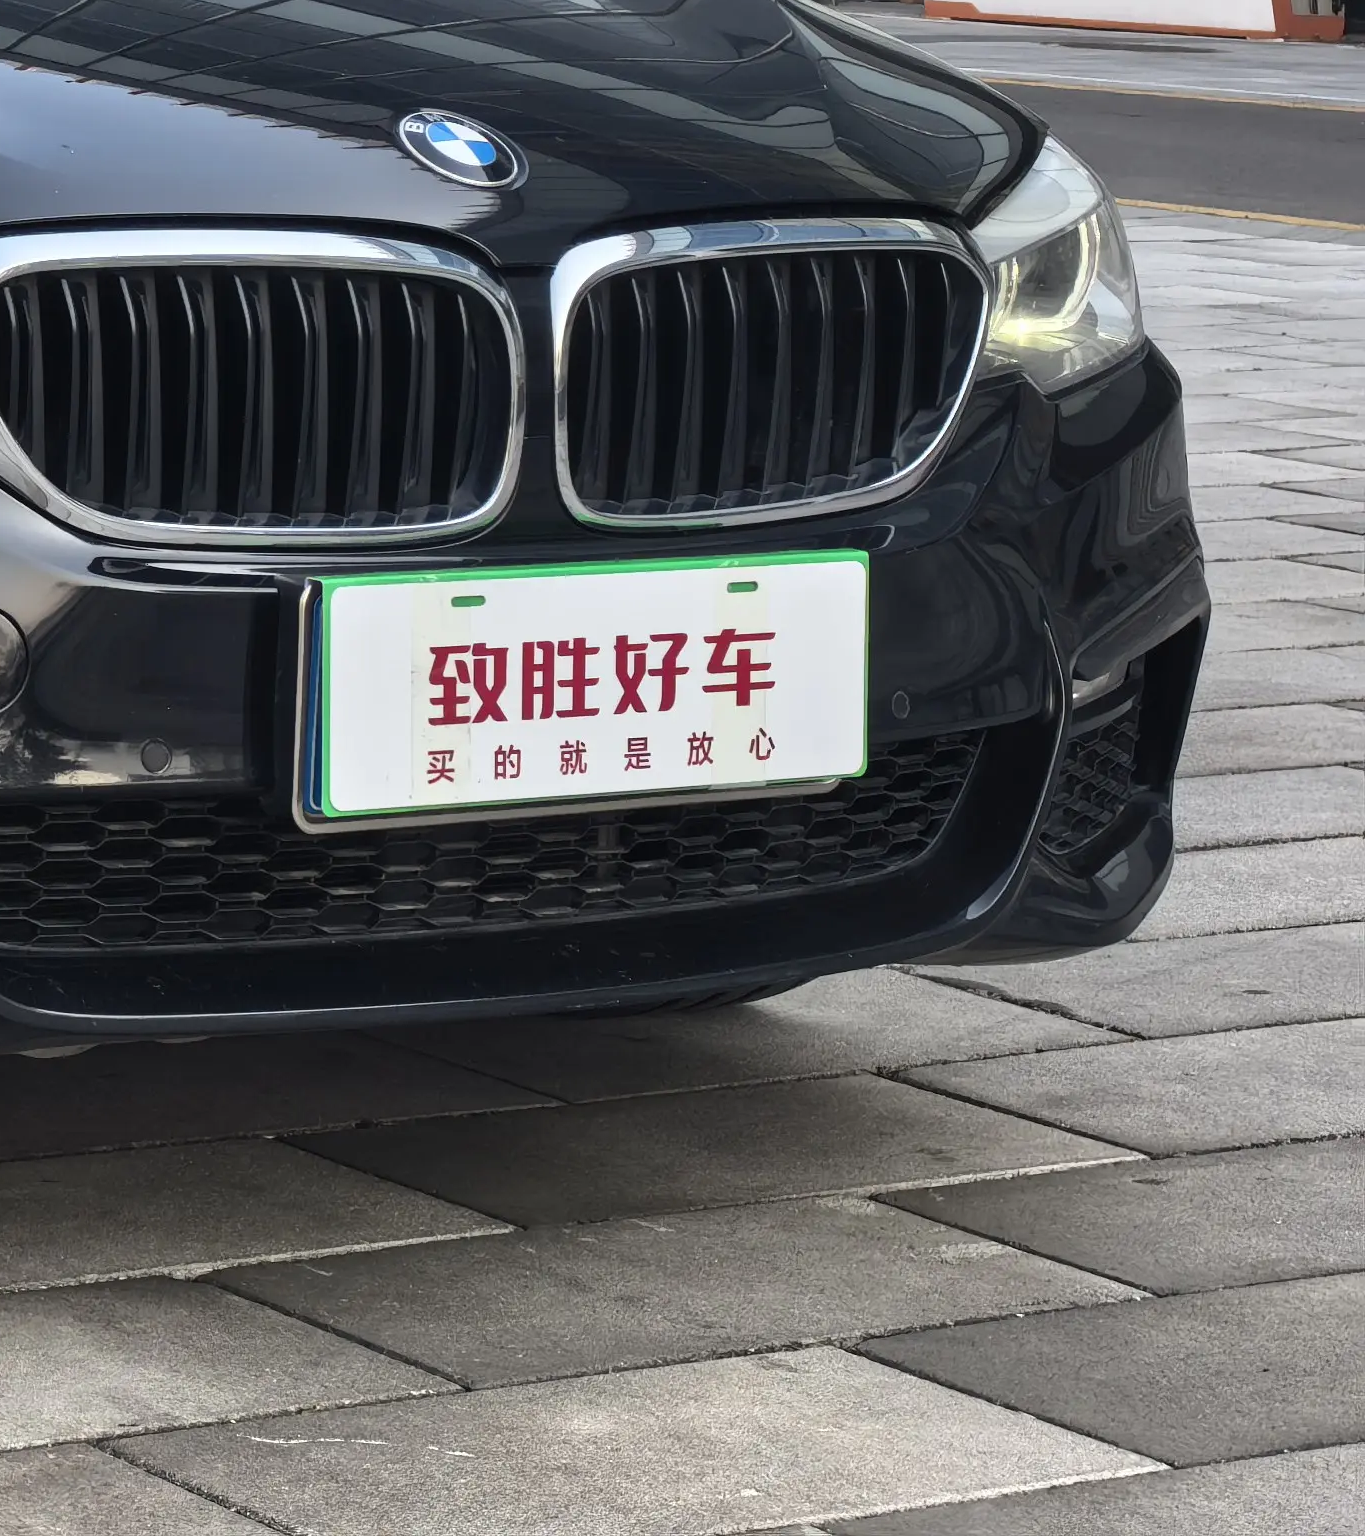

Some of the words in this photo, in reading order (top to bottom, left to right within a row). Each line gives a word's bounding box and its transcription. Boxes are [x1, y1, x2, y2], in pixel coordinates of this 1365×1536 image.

[428, 628, 776, 727] 致胜好车
[426, 727, 776, 785] 买的就是放心
